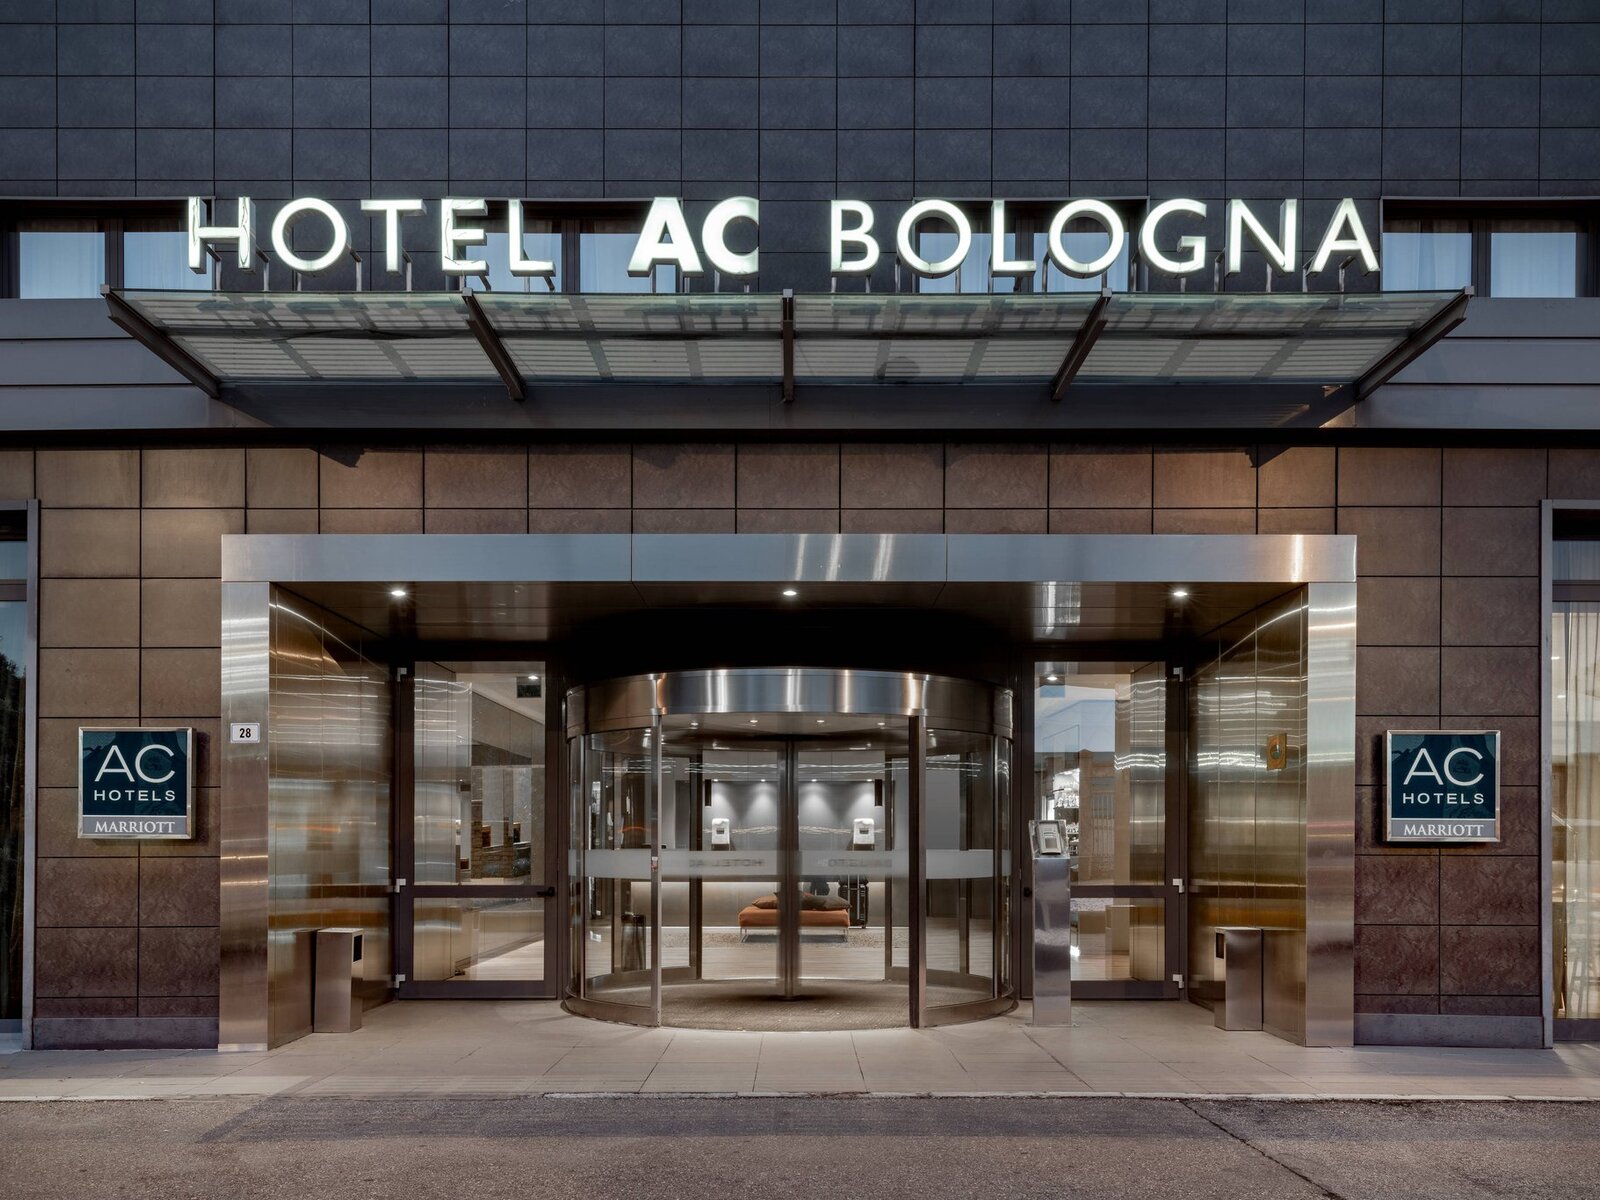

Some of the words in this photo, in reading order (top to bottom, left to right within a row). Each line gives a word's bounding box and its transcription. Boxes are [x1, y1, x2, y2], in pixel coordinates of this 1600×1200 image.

[188, 196, 556, 277] HOTEL
[627, 196, 760, 276] AC
[831, 198, 1380, 278] BOLOGNA
[239, 727, 252, 739] 28
[94, 744, 175, 783] AC
[1403, 747, 1484, 786] AC
[94, 789, 176, 801] HOTELS
[1402, 792, 1484, 805] HOTELS
[95, 821, 175, 834] MARRIOTT
[1403, 824, 1484, 836] MARRIOTT
